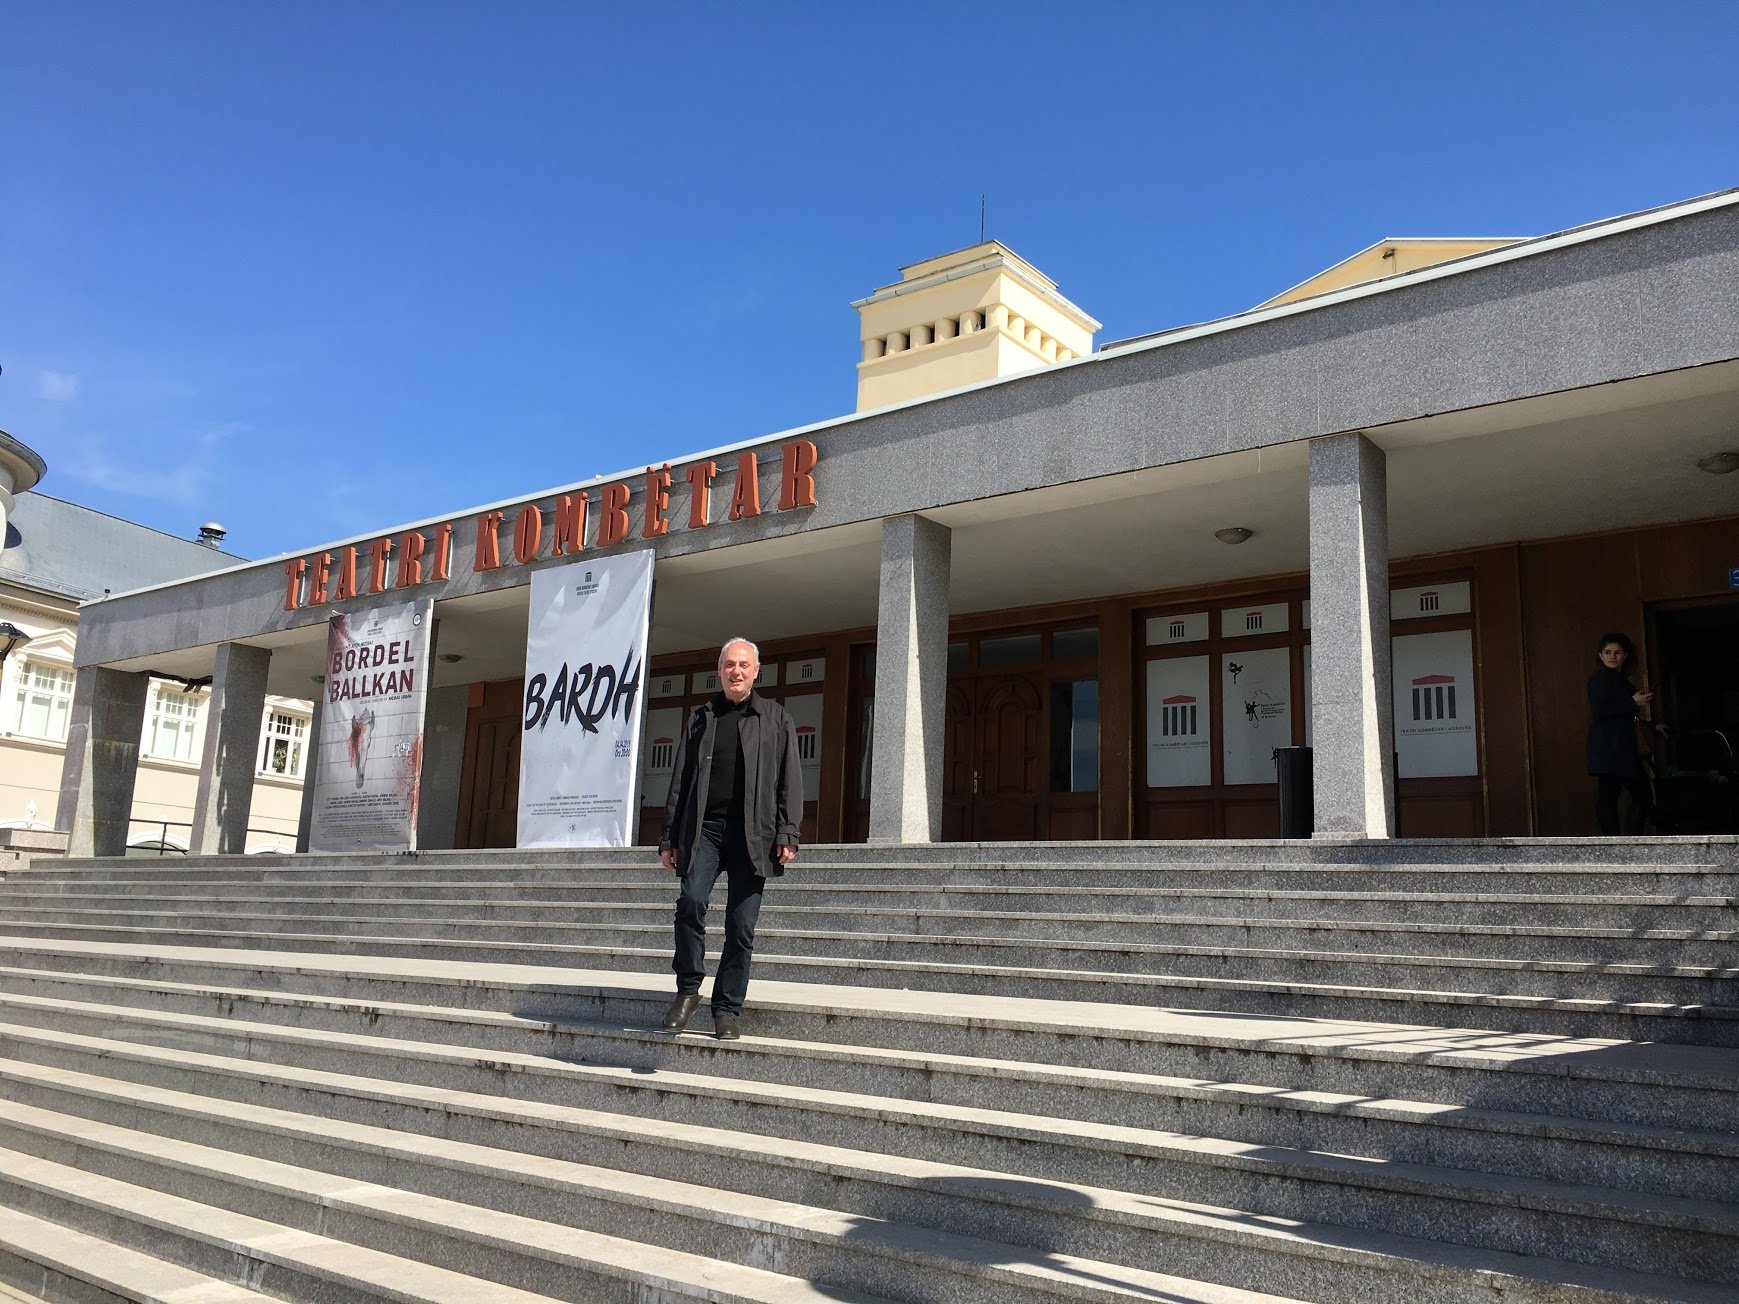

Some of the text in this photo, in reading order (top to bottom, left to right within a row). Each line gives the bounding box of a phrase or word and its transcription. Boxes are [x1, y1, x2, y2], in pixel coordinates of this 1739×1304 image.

[284, 439, 818, 611] TEATRI KOMBËTAR
[329, 668, 415, 704] BALLKAN
[332, 639, 415, 675] BORDEL
[525, 640, 641, 740] BARDH
